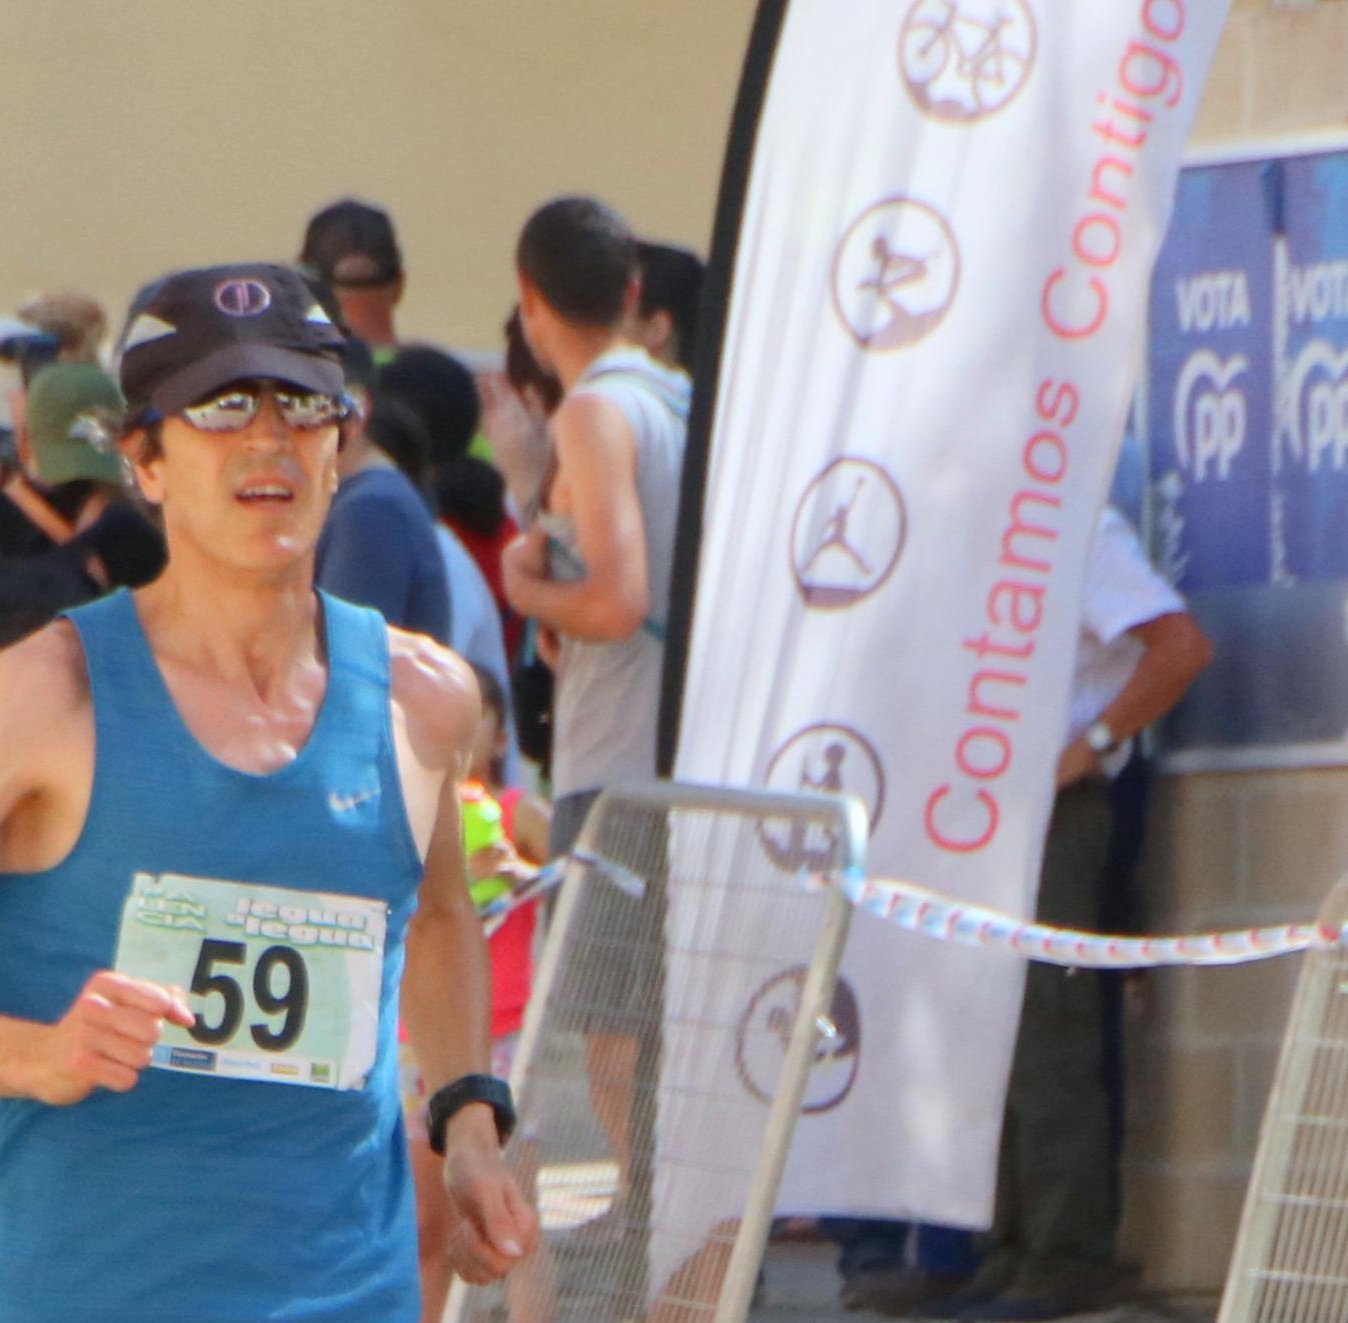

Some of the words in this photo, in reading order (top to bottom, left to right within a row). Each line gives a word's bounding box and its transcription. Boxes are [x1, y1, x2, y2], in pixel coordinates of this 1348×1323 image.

[1176, 271, 1251, 333] VOTA
[924, 378, 1080, 854] Contamos
[1042, 0, 1186, 341] Contigo
[236, 896, 367, 930] legua
[244, 916, 375, 951] legua
[188, 938, 309, 1052] 59
